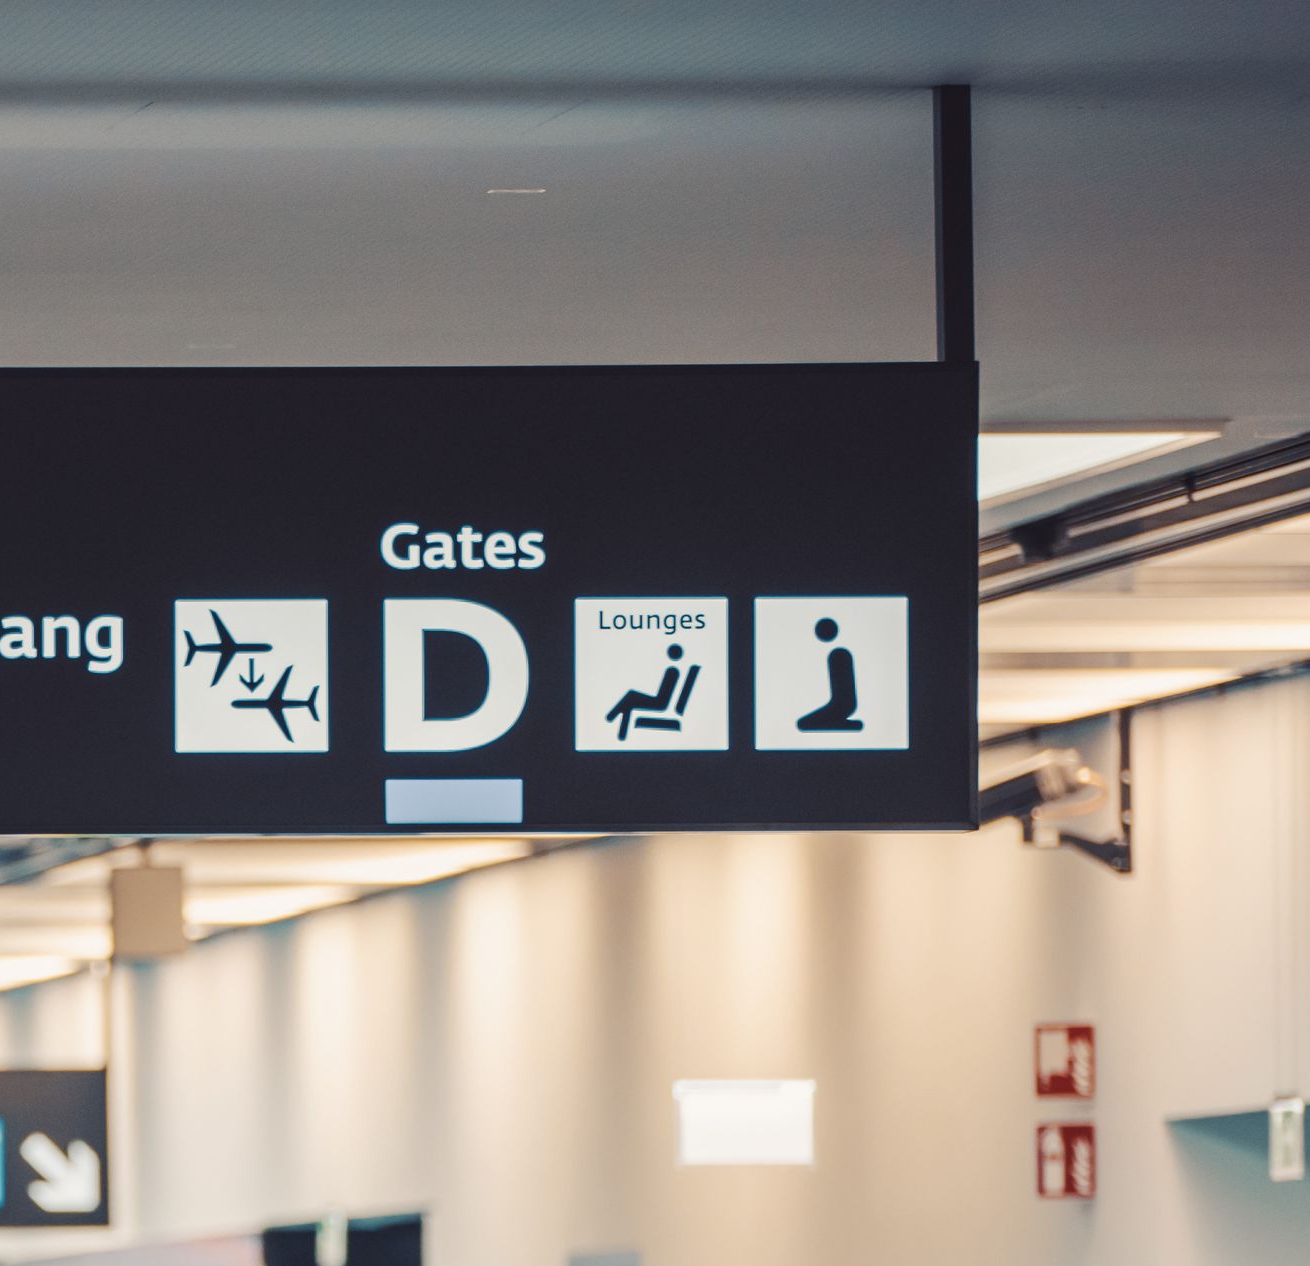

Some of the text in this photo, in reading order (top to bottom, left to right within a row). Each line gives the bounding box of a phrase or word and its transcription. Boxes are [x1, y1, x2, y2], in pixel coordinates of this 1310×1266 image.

[380, 522, 546, 570] Gates
[598, 610, 707, 636] Lounges
[383, 598, 530, 753] D
